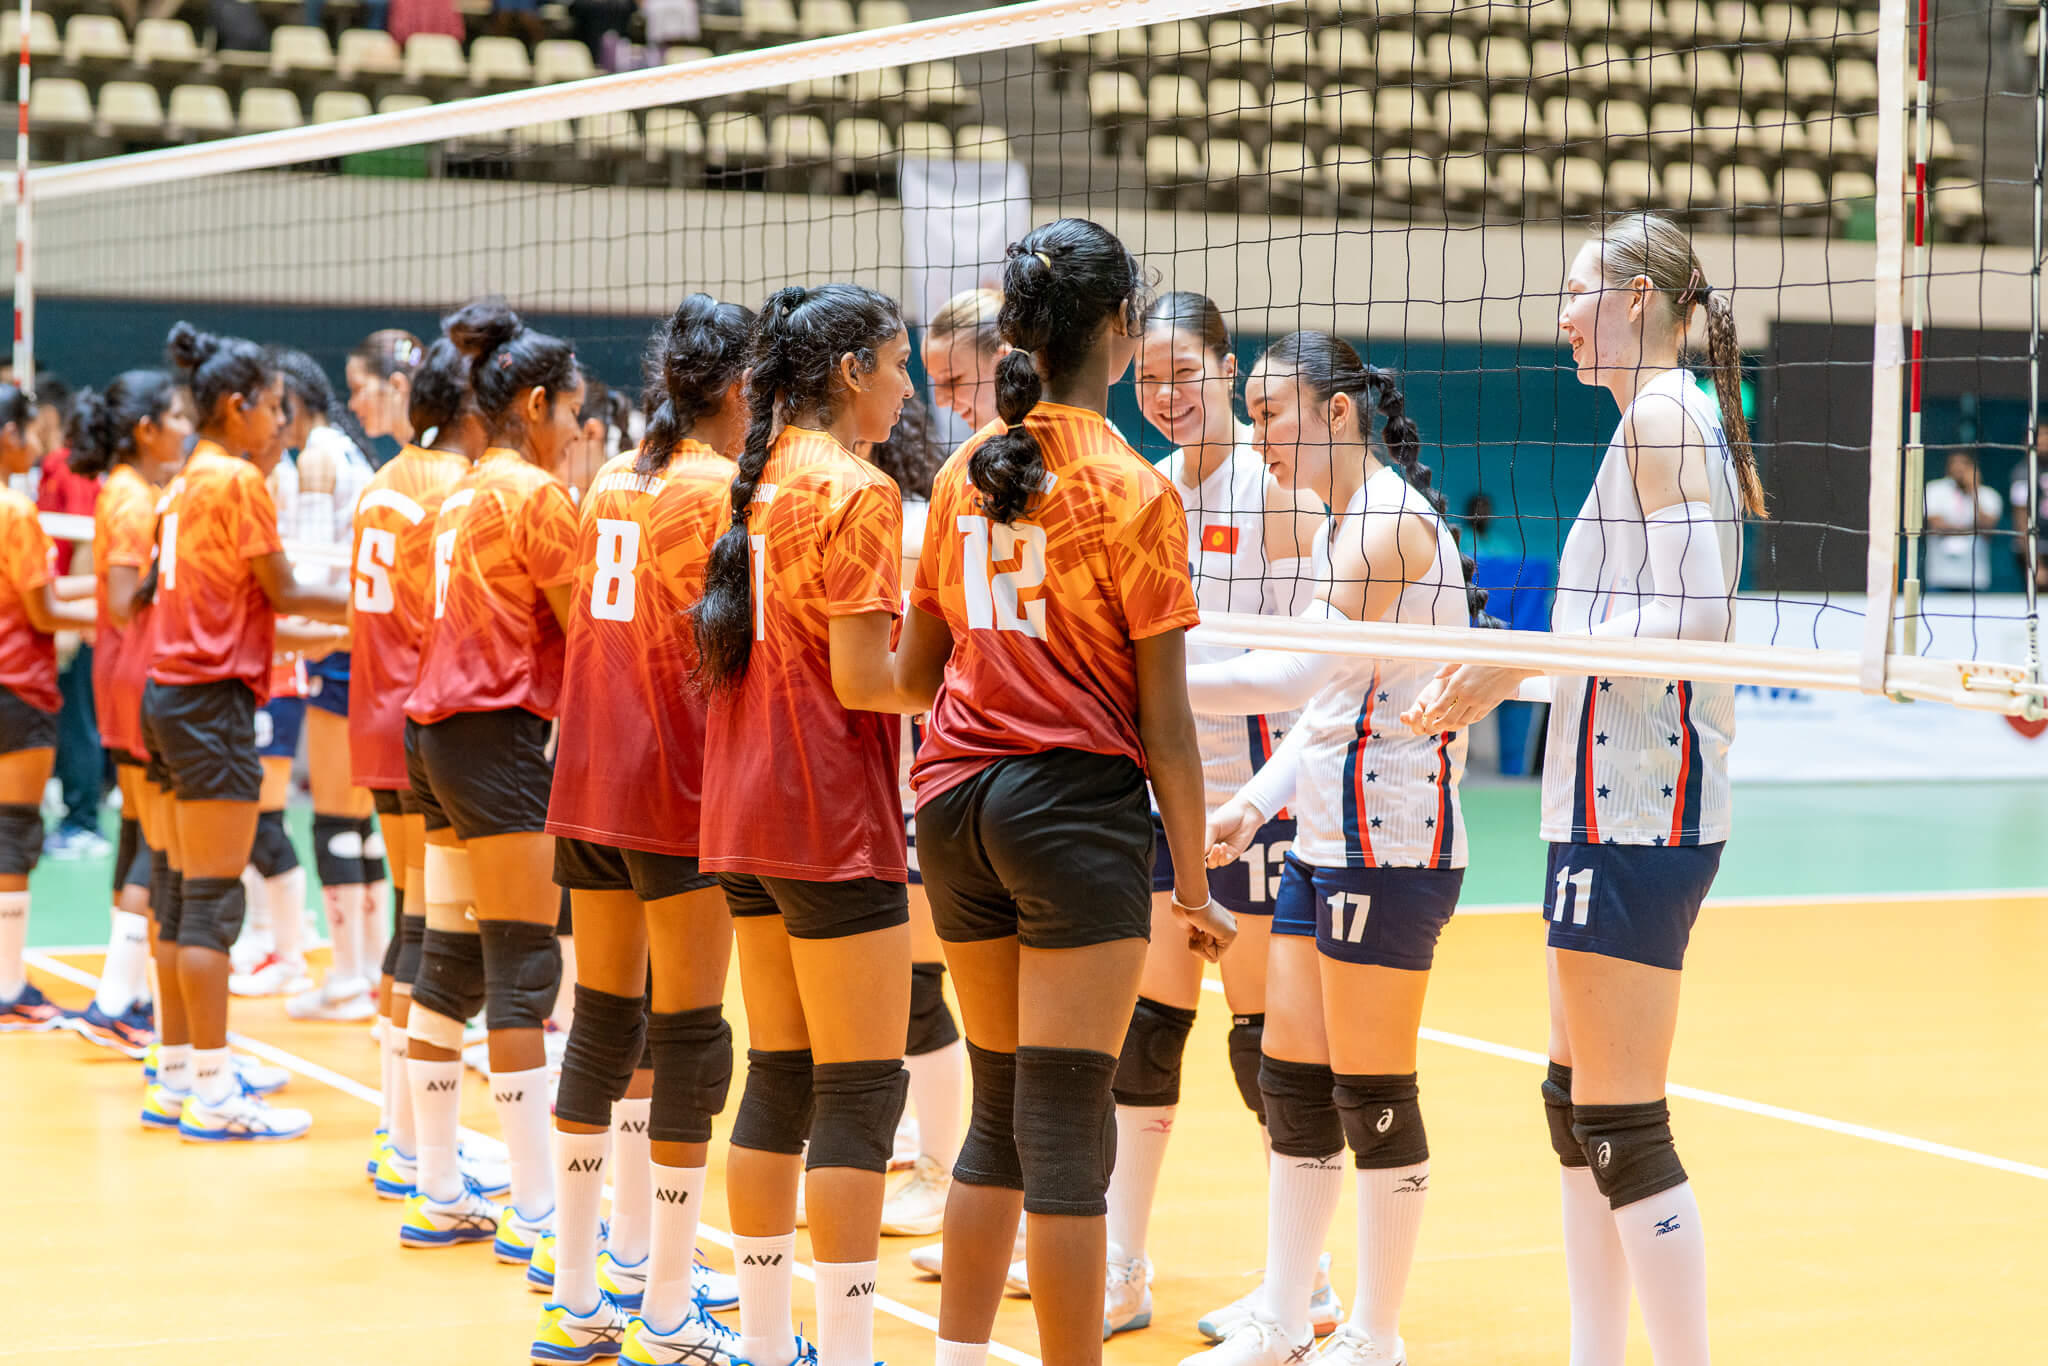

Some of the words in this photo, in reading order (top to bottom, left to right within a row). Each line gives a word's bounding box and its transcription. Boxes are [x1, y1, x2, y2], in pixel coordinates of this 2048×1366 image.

[354, 527, 397, 614] 5
[590, 518, 641, 622] 8
[956, 515, 1049, 642] 12
[1326, 891, 1371, 943] 17
[1552, 866, 1594, 925] 11
